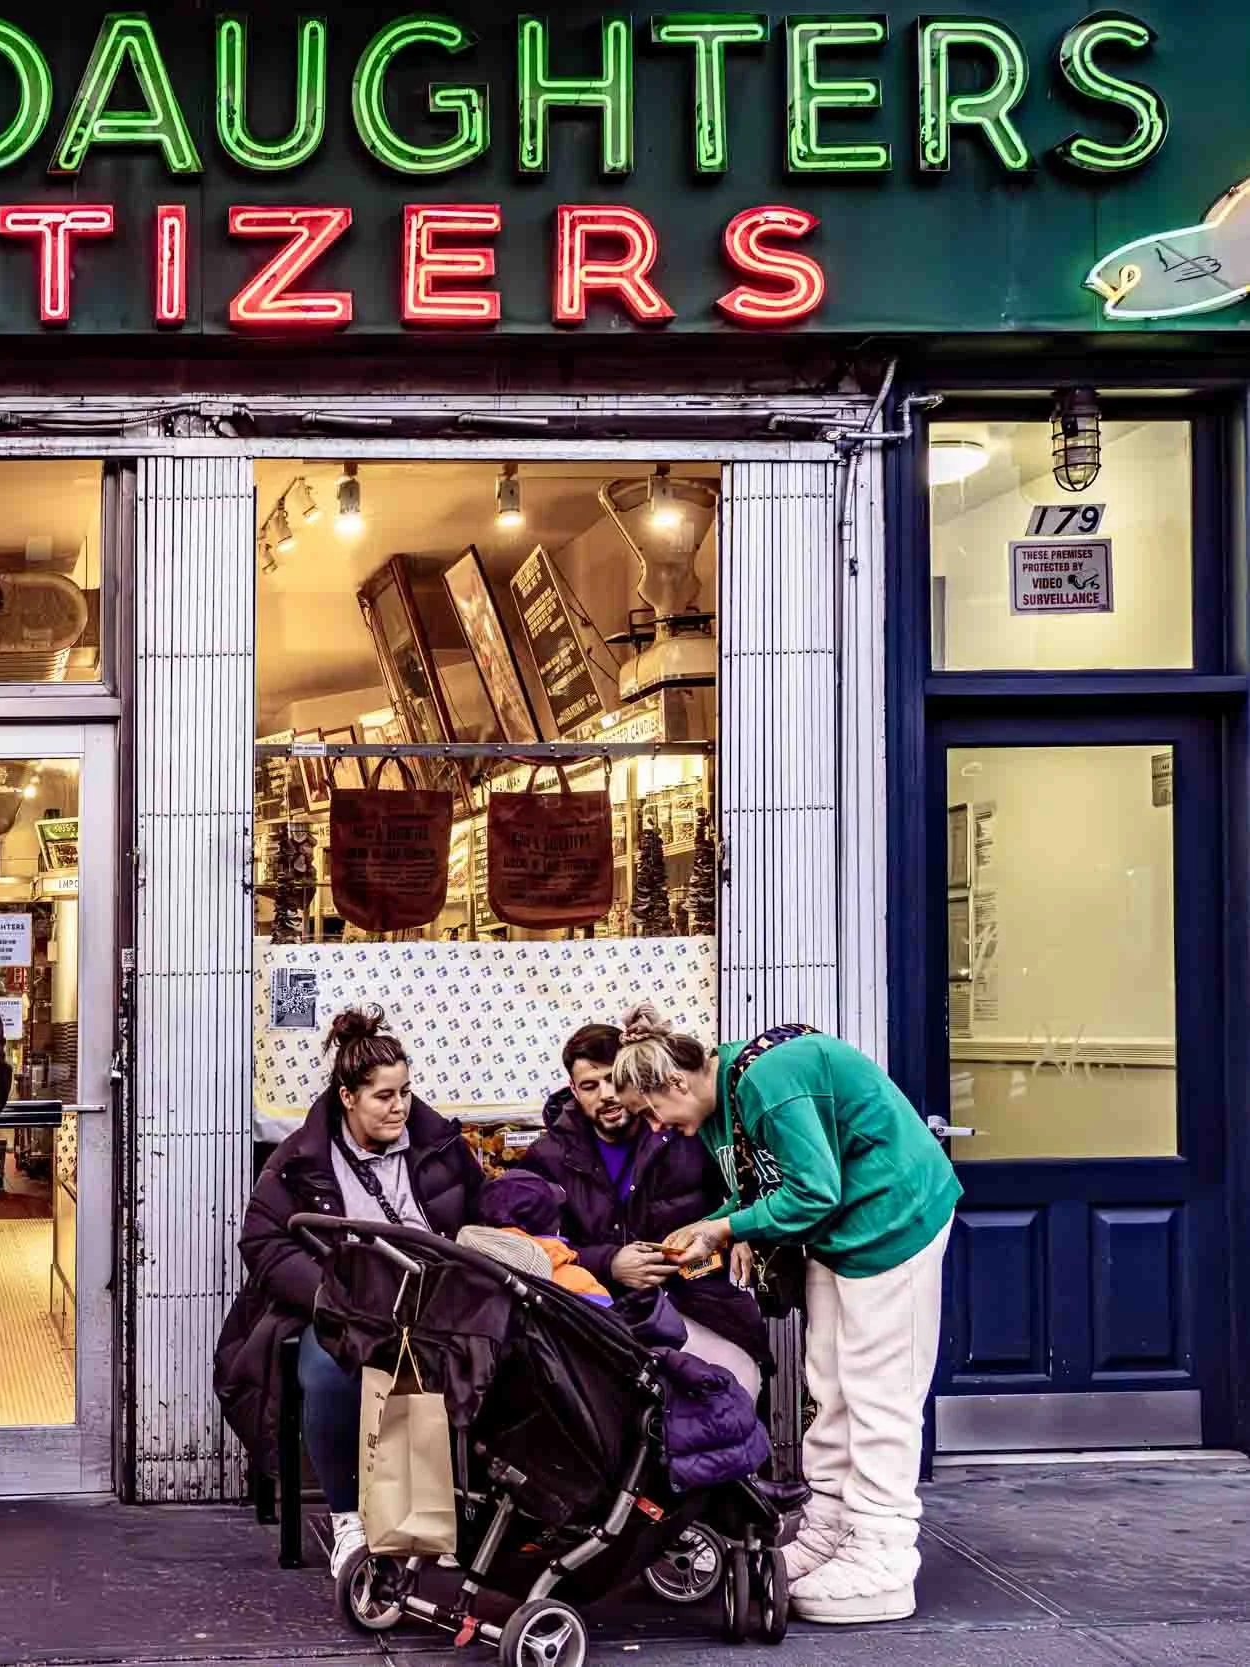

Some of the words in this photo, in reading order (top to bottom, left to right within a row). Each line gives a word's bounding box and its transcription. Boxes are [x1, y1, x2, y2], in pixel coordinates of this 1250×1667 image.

[1034, 505, 1100, 534] 179
[1022, 550, 1049, 561] THESE
[1051, 548, 1093, 560] PREMISES
[1022, 562, 1070, 573] PROTECTED
[1072, 561, 1083, 572] BY
[1032, 576, 1063, 590] VIDEO
[1022, 592, 1100, 607] SURVEILLANCE
